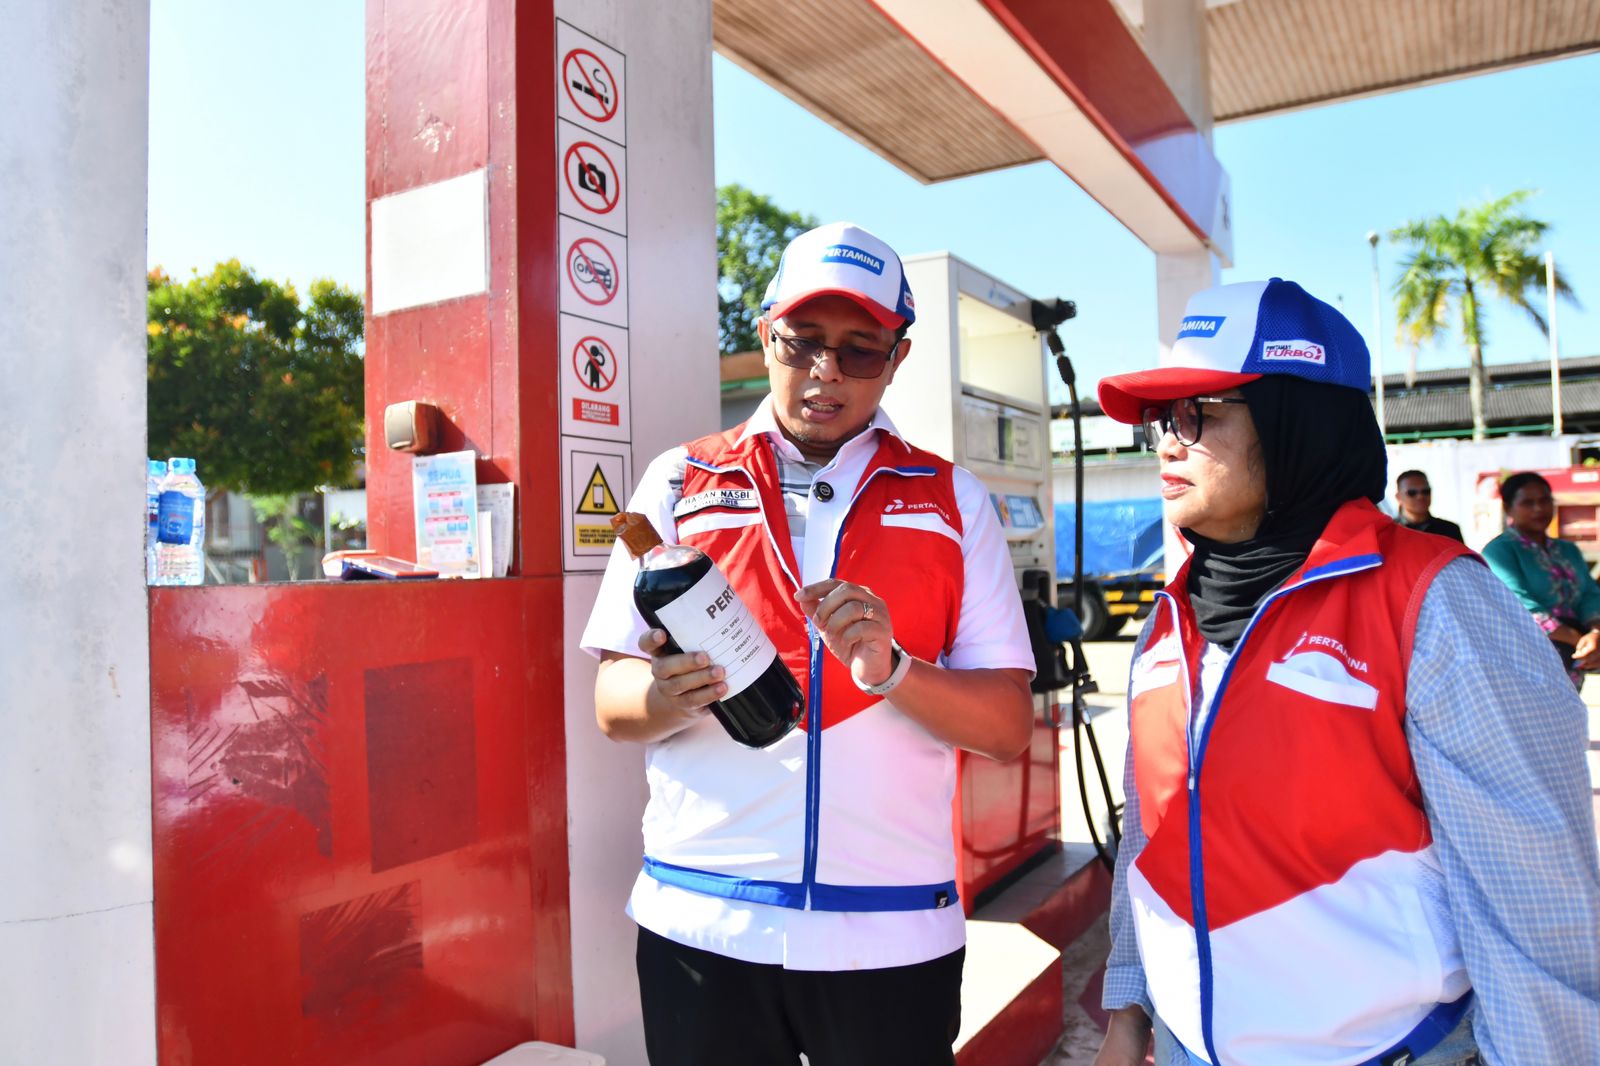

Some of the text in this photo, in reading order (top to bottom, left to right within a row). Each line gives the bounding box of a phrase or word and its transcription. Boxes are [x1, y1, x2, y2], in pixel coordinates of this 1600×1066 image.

[825, 248, 880, 270] RTAMINA
[1181, 320, 1216, 331] AMINA
[1266, 349, 1314, 359] TURBO
[720, 490, 750, 499] NASBI
[734, 635, 752, 653] DENSITY
[741, 644, 760, 664] TANGGAL
